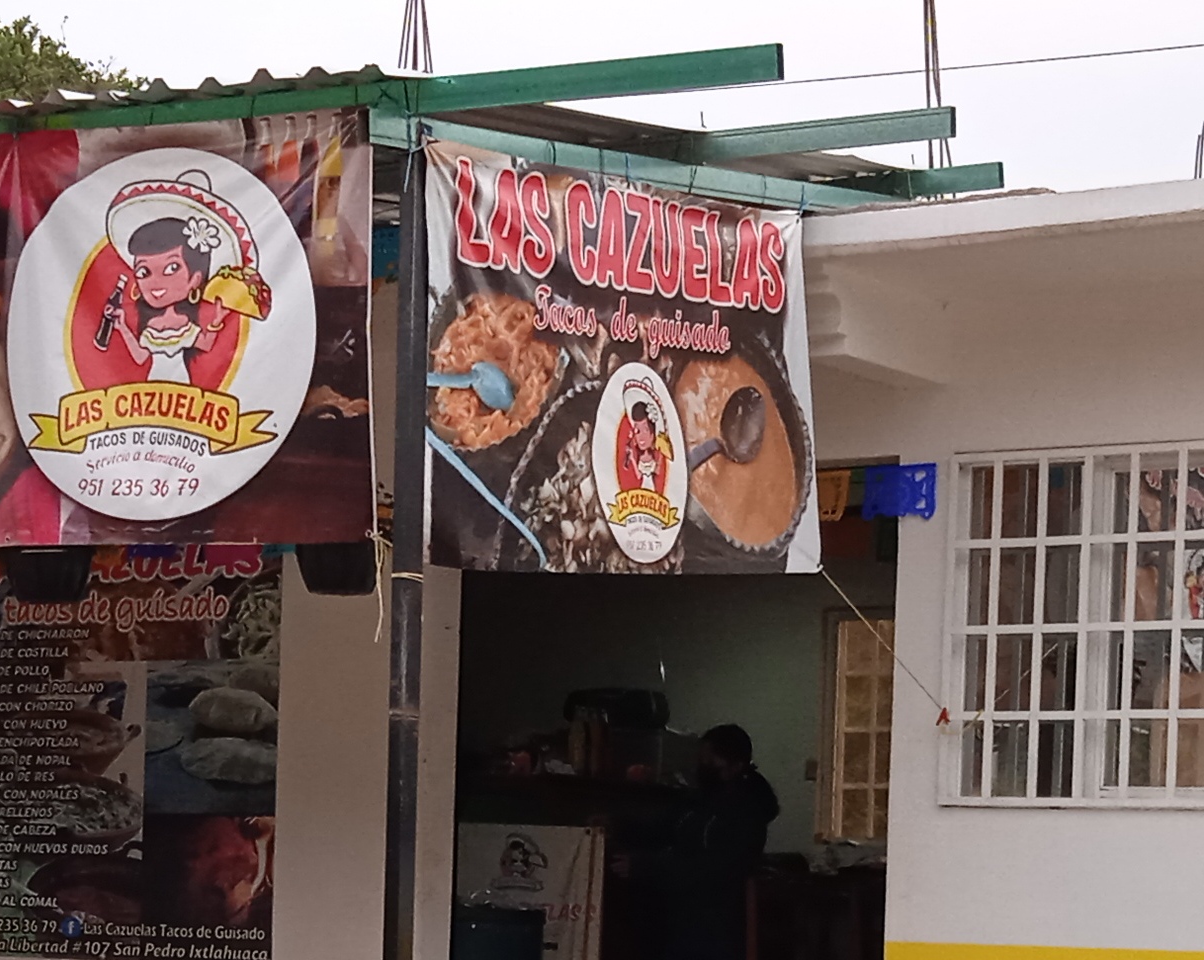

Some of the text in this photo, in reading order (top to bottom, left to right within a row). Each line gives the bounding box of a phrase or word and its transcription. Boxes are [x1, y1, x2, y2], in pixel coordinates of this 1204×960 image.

[455, 156, 787, 314] LAS CAZUELAS
[533, 284, 732, 359] Tacos de guisado
[64, 391, 230, 432] LAS CAZUELAS
[90, 431, 207, 457] TACOS DE GUISADOS
[133, 451, 142, 461] a
[78, 477, 200, 498] 951 235 36 79
[4, 587, 229, 633] tacos de guisado
[0, 630, 13, 641] DE
[18, 629, 89, 641] CHICHARRON
[0, 648, 13, 659] DE
[17, 647, 69, 658] COSTILLA
[15, 665, 50, 676] POLLO
[0, 684, 13, 694] DE
[17, 683, 48, 694] CHILE
[24, 701, 74, 711] CHORIZO
[4, 719, 26, 730] CON
[30, 719, 67, 729] HUEVO
[18, 755, 32, 766] DE
[36, 755, 71, 766] NOPAL
[17, 771, 31, 782] DE
[34, 771, 55, 782] RES
[3, 789, 27, 799] CON
[30, 789, 79, 800] NOPALES
[0, 806, 54, 818] RELLENOS
[13, 824, 56, 835] CABEZA
[23, 843, 67, 854] HUEVOS
[71, 844, 109, 855] DUROS
[2, 896, 16, 906] AL
[20, 896, 58, 907] COMAL
[23, 919, 38, 932] 36
[42, 920, 57, 932] 79
[84, 923, 102, 935] Las
[106, 922, 157, 937] Cazuelas
[160, 924, 193, 938] Tacos
[196, 925, 212, 938] de
[214, 925, 265, 941] Guisado
[10, 938, 68, 953] Libertad
[113, 942, 141, 957] San
[144, 943, 186, 958] Pedro
[189, 944, 268, 960] Ixtlahuaca
